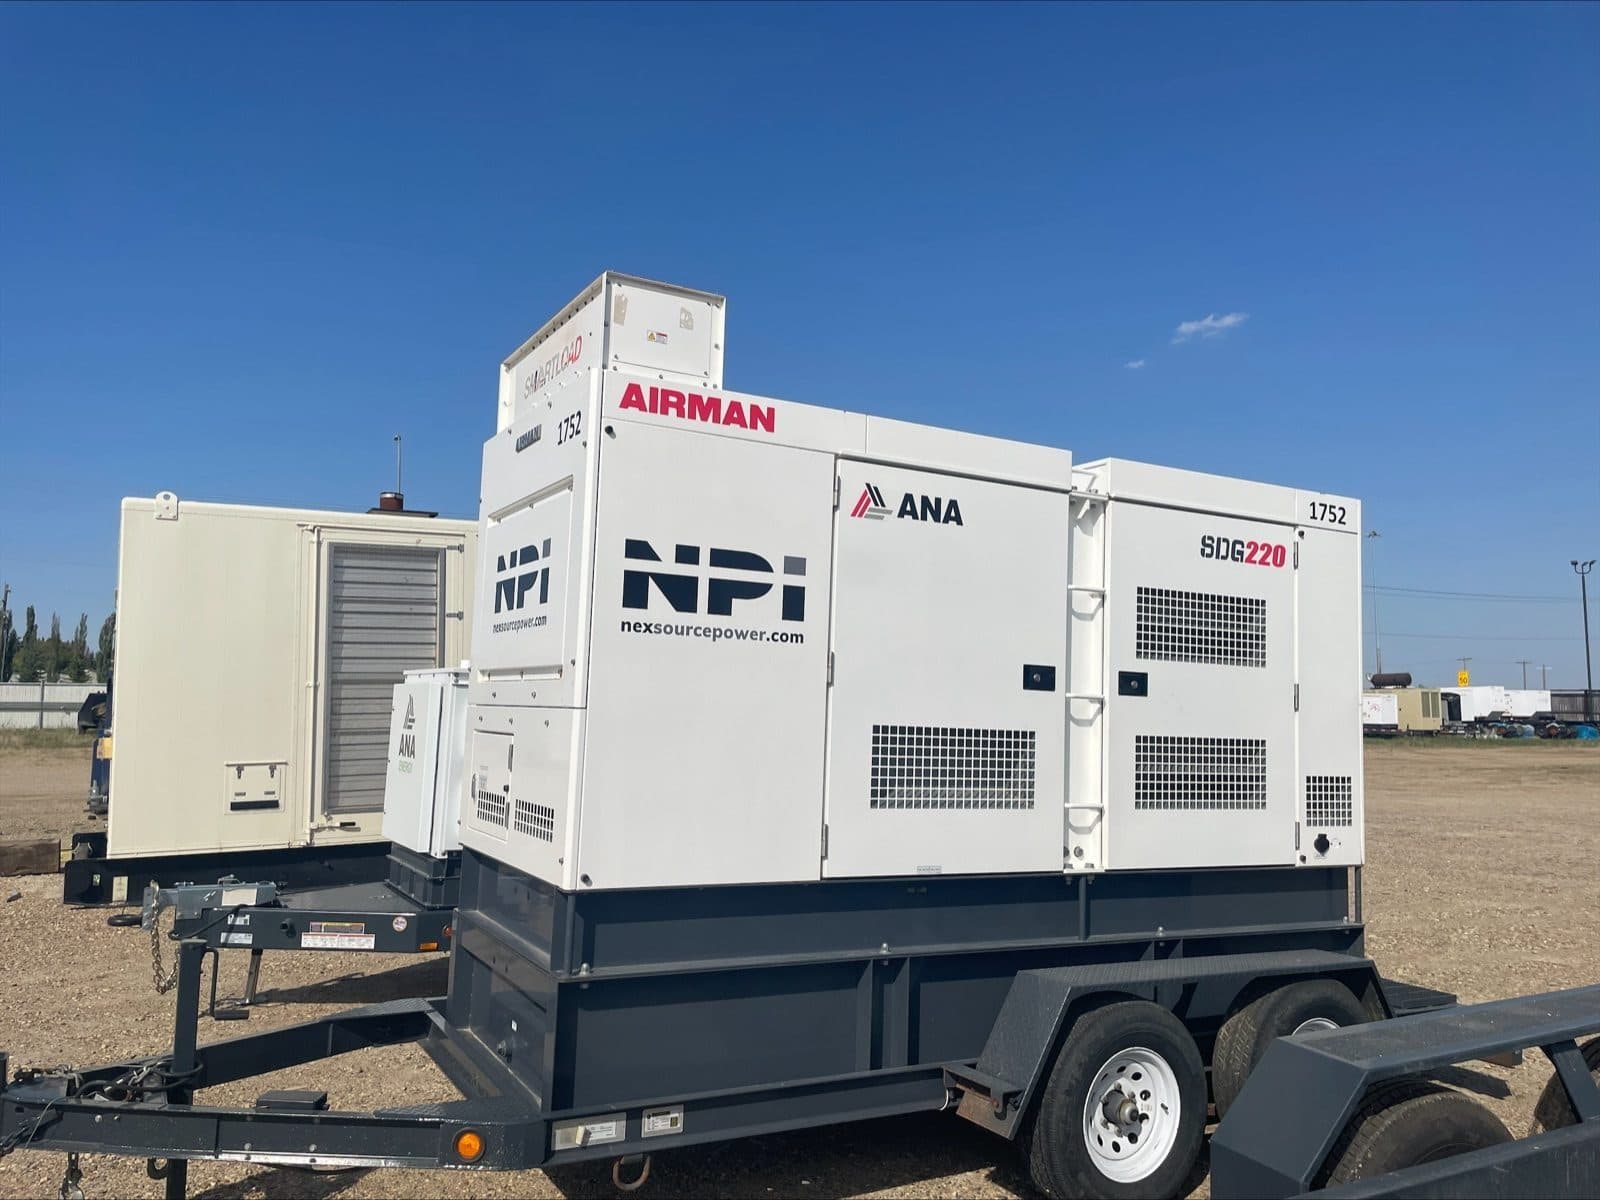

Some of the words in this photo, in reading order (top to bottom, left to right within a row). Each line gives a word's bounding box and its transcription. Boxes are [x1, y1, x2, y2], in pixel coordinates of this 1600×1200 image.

[619, 382, 775, 433] AIRMAN
[557, 410, 582, 446] 1752
[897, 492, 964, 526] ANA
[1309, 501, 1347, 525] 1752
[1200, 535, 1286, 568] SDG220
[492, 615, 548, 634] nexsourcepower.com
[620, 620, 804, 644] nexsourcepower.com
[399, 733, 416, 759] ANA
